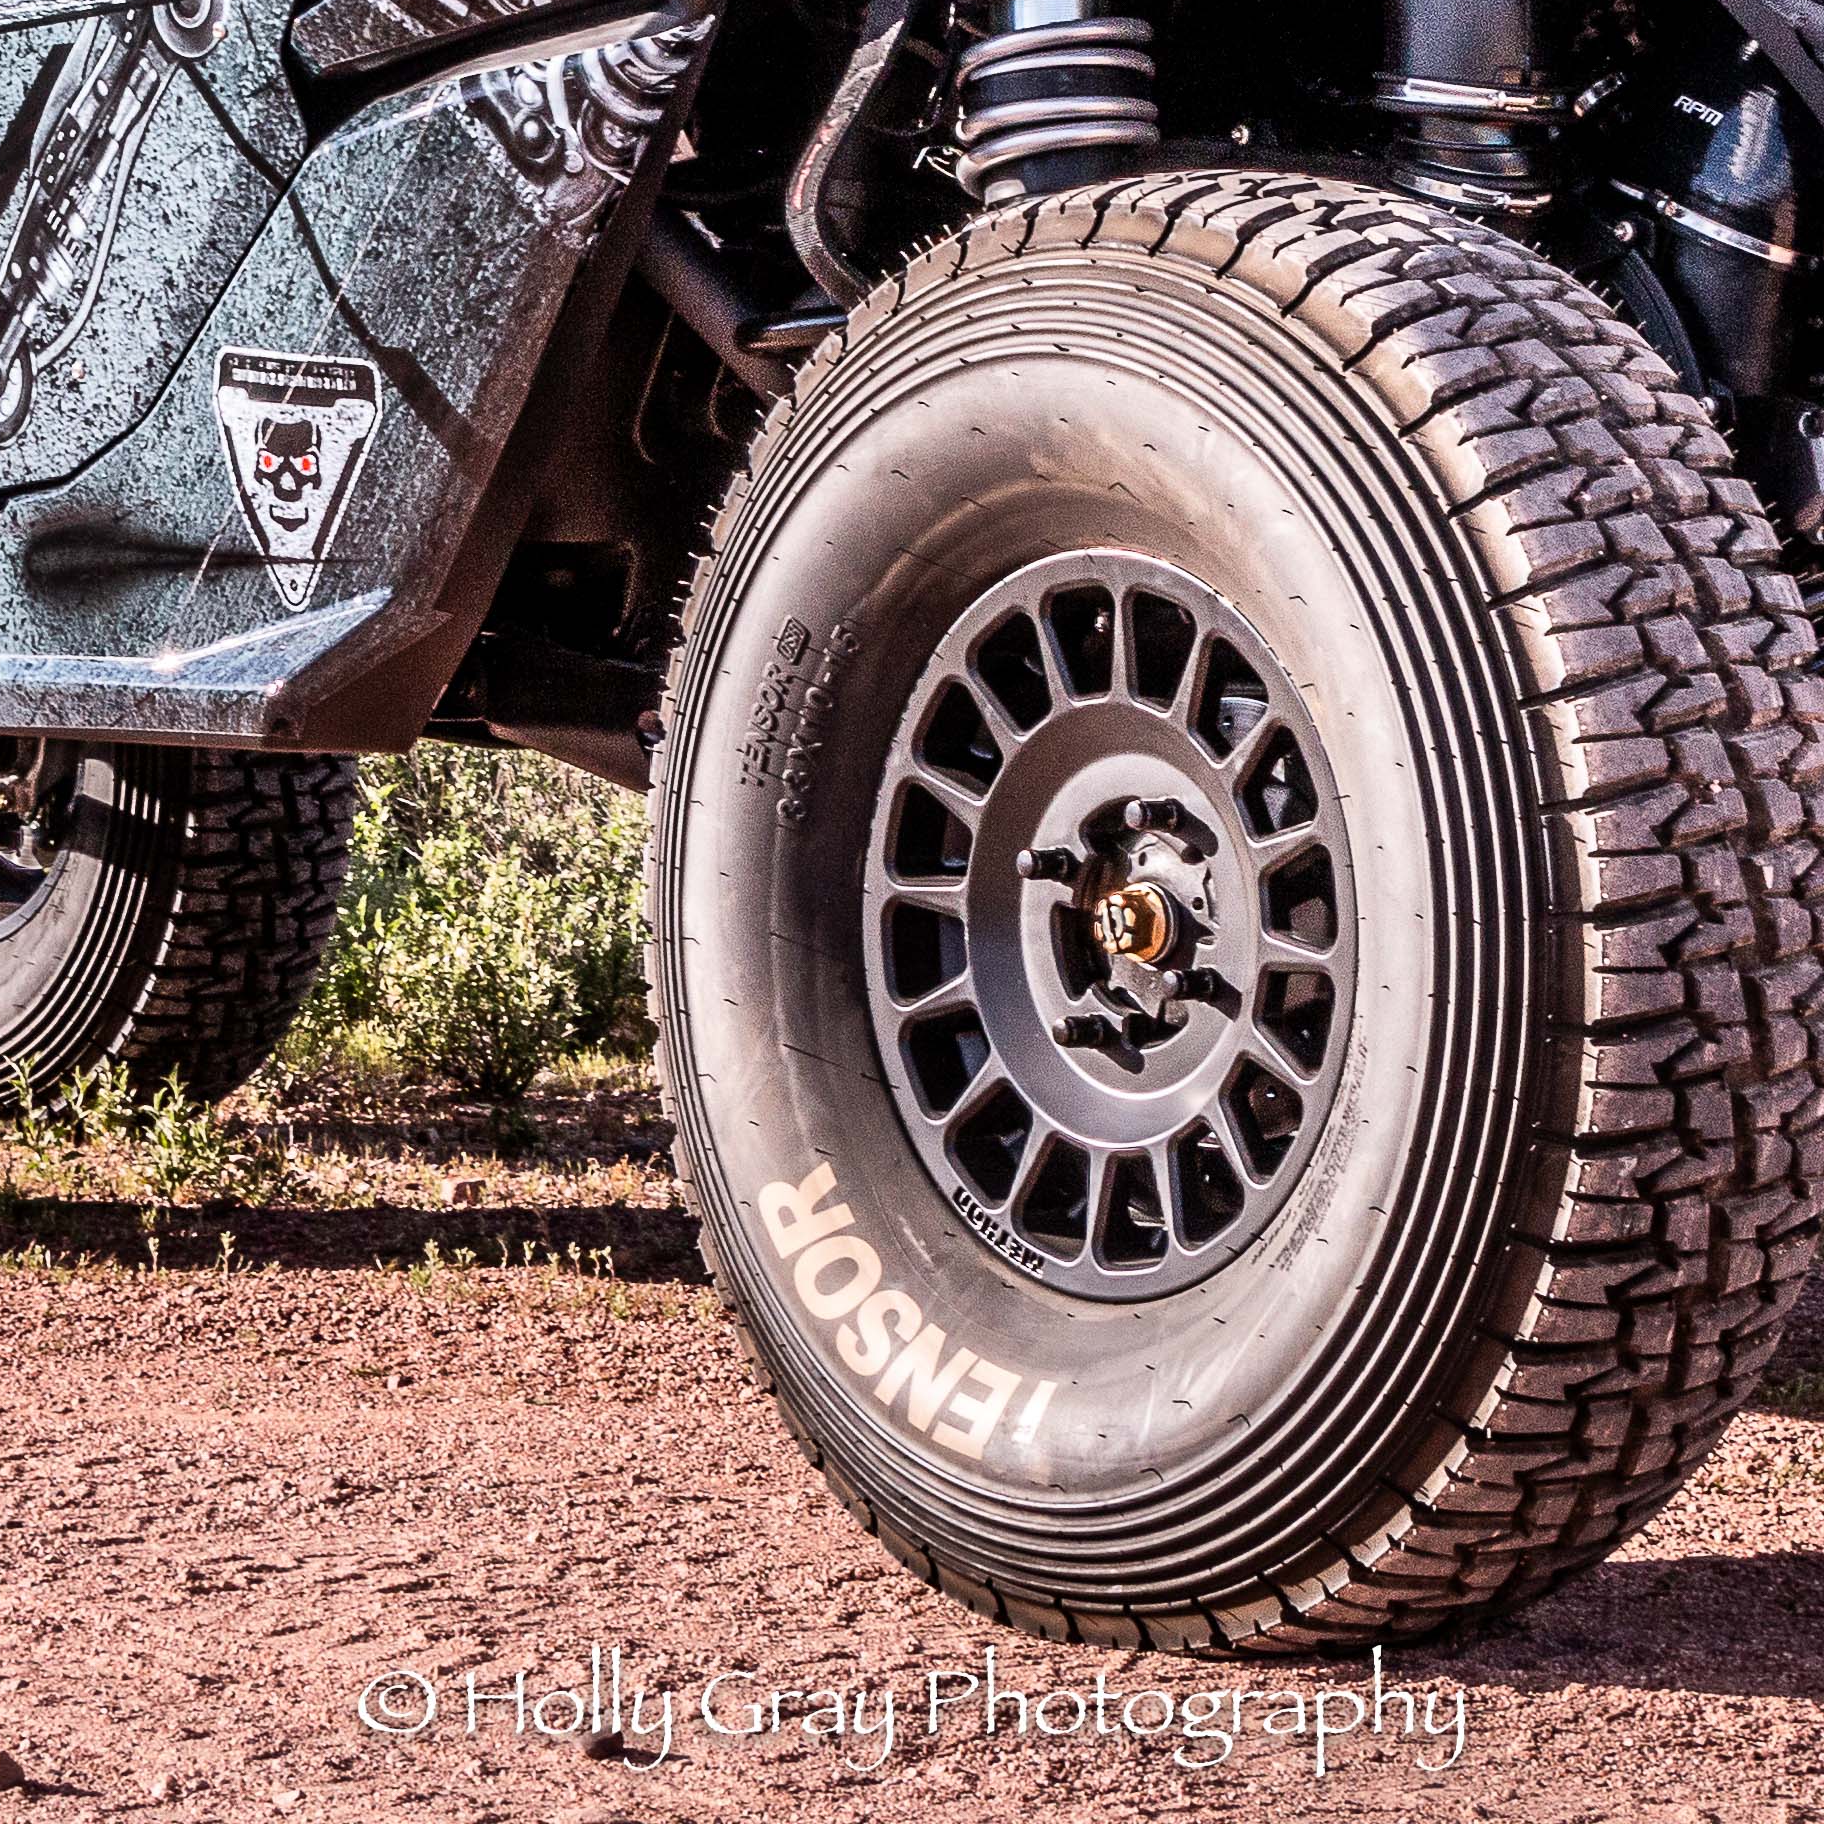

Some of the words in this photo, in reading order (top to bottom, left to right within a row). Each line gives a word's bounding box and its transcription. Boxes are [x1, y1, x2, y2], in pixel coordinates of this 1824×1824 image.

[1672, 94, 1725, 127] RPM
[738, 661, 795, 789] TENSOR
[757, 1160, 1058, 1466] TENSOR
